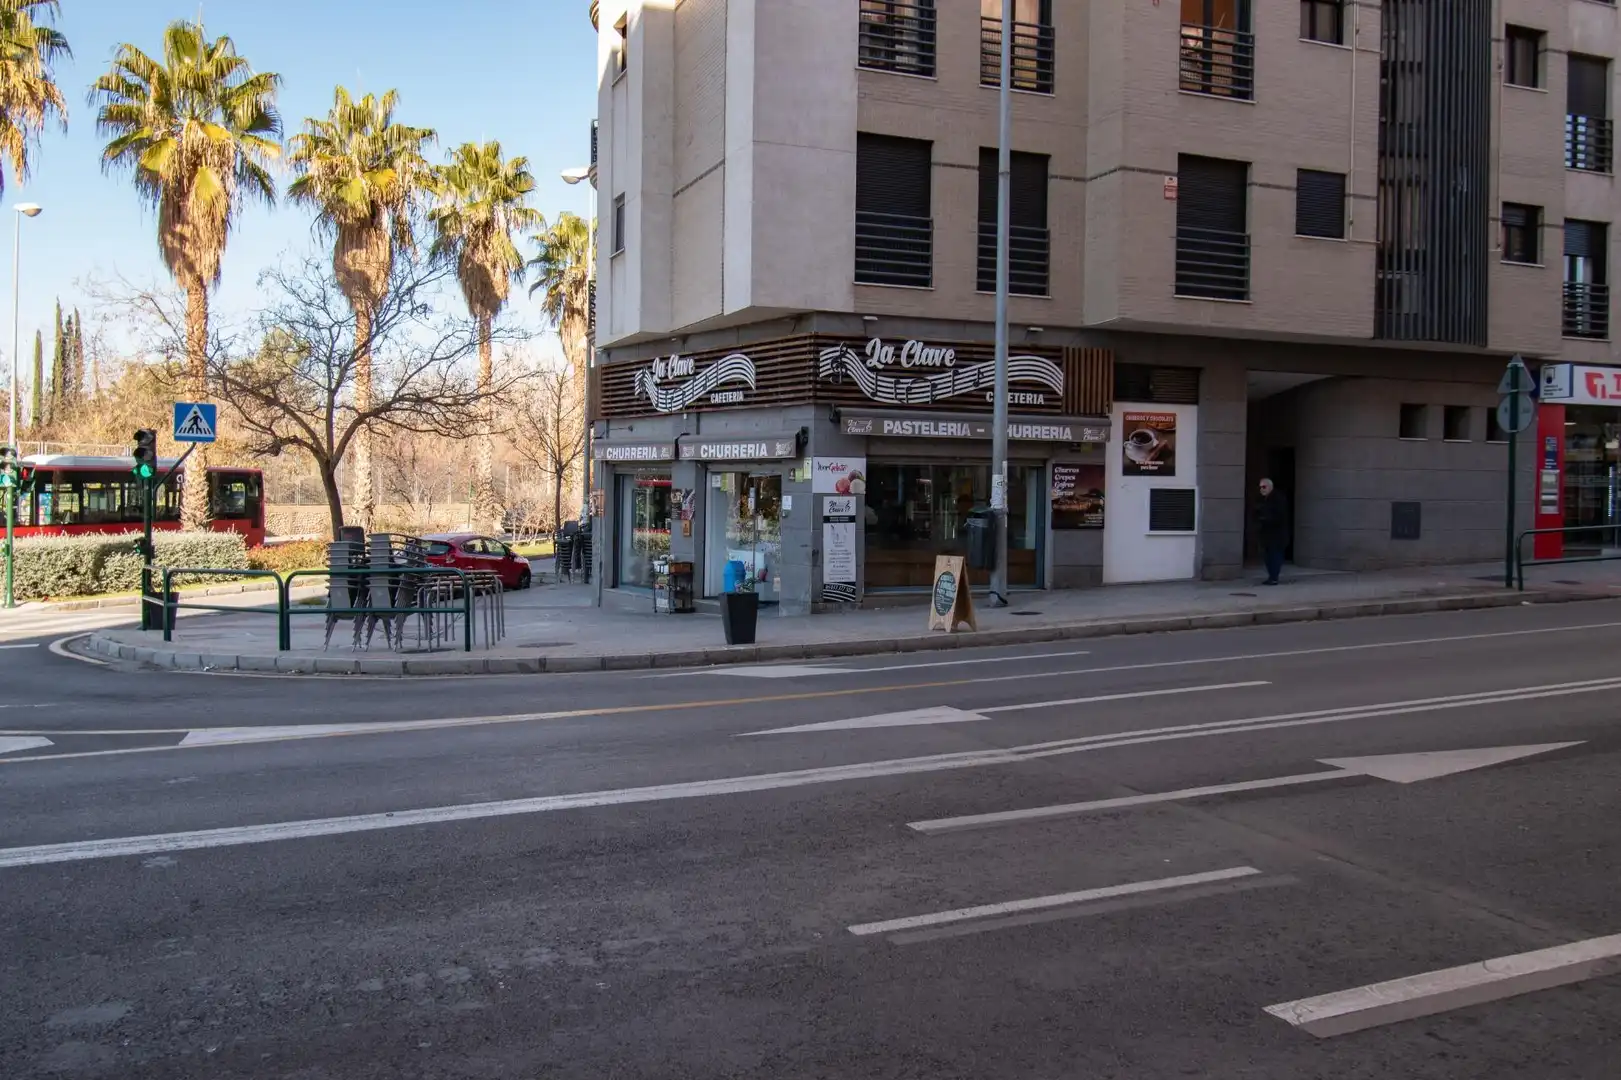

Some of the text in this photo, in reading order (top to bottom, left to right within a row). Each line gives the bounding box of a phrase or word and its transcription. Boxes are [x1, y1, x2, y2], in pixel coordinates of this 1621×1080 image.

[865, 338, 956, 369] La Clave
[652, 354, 695, 383] La Clave
[710, 391, 744, 403] CAFETERIA
[985, 391, 1045, 405] CETERIA
[883, 420, 971, 437] PASTELERIA
[1006, 424, 1072, 440] HURRERIA
[606, 446, 658, 459] CHURRERIA
[700, 443, 768, 458] CHURRERIA
